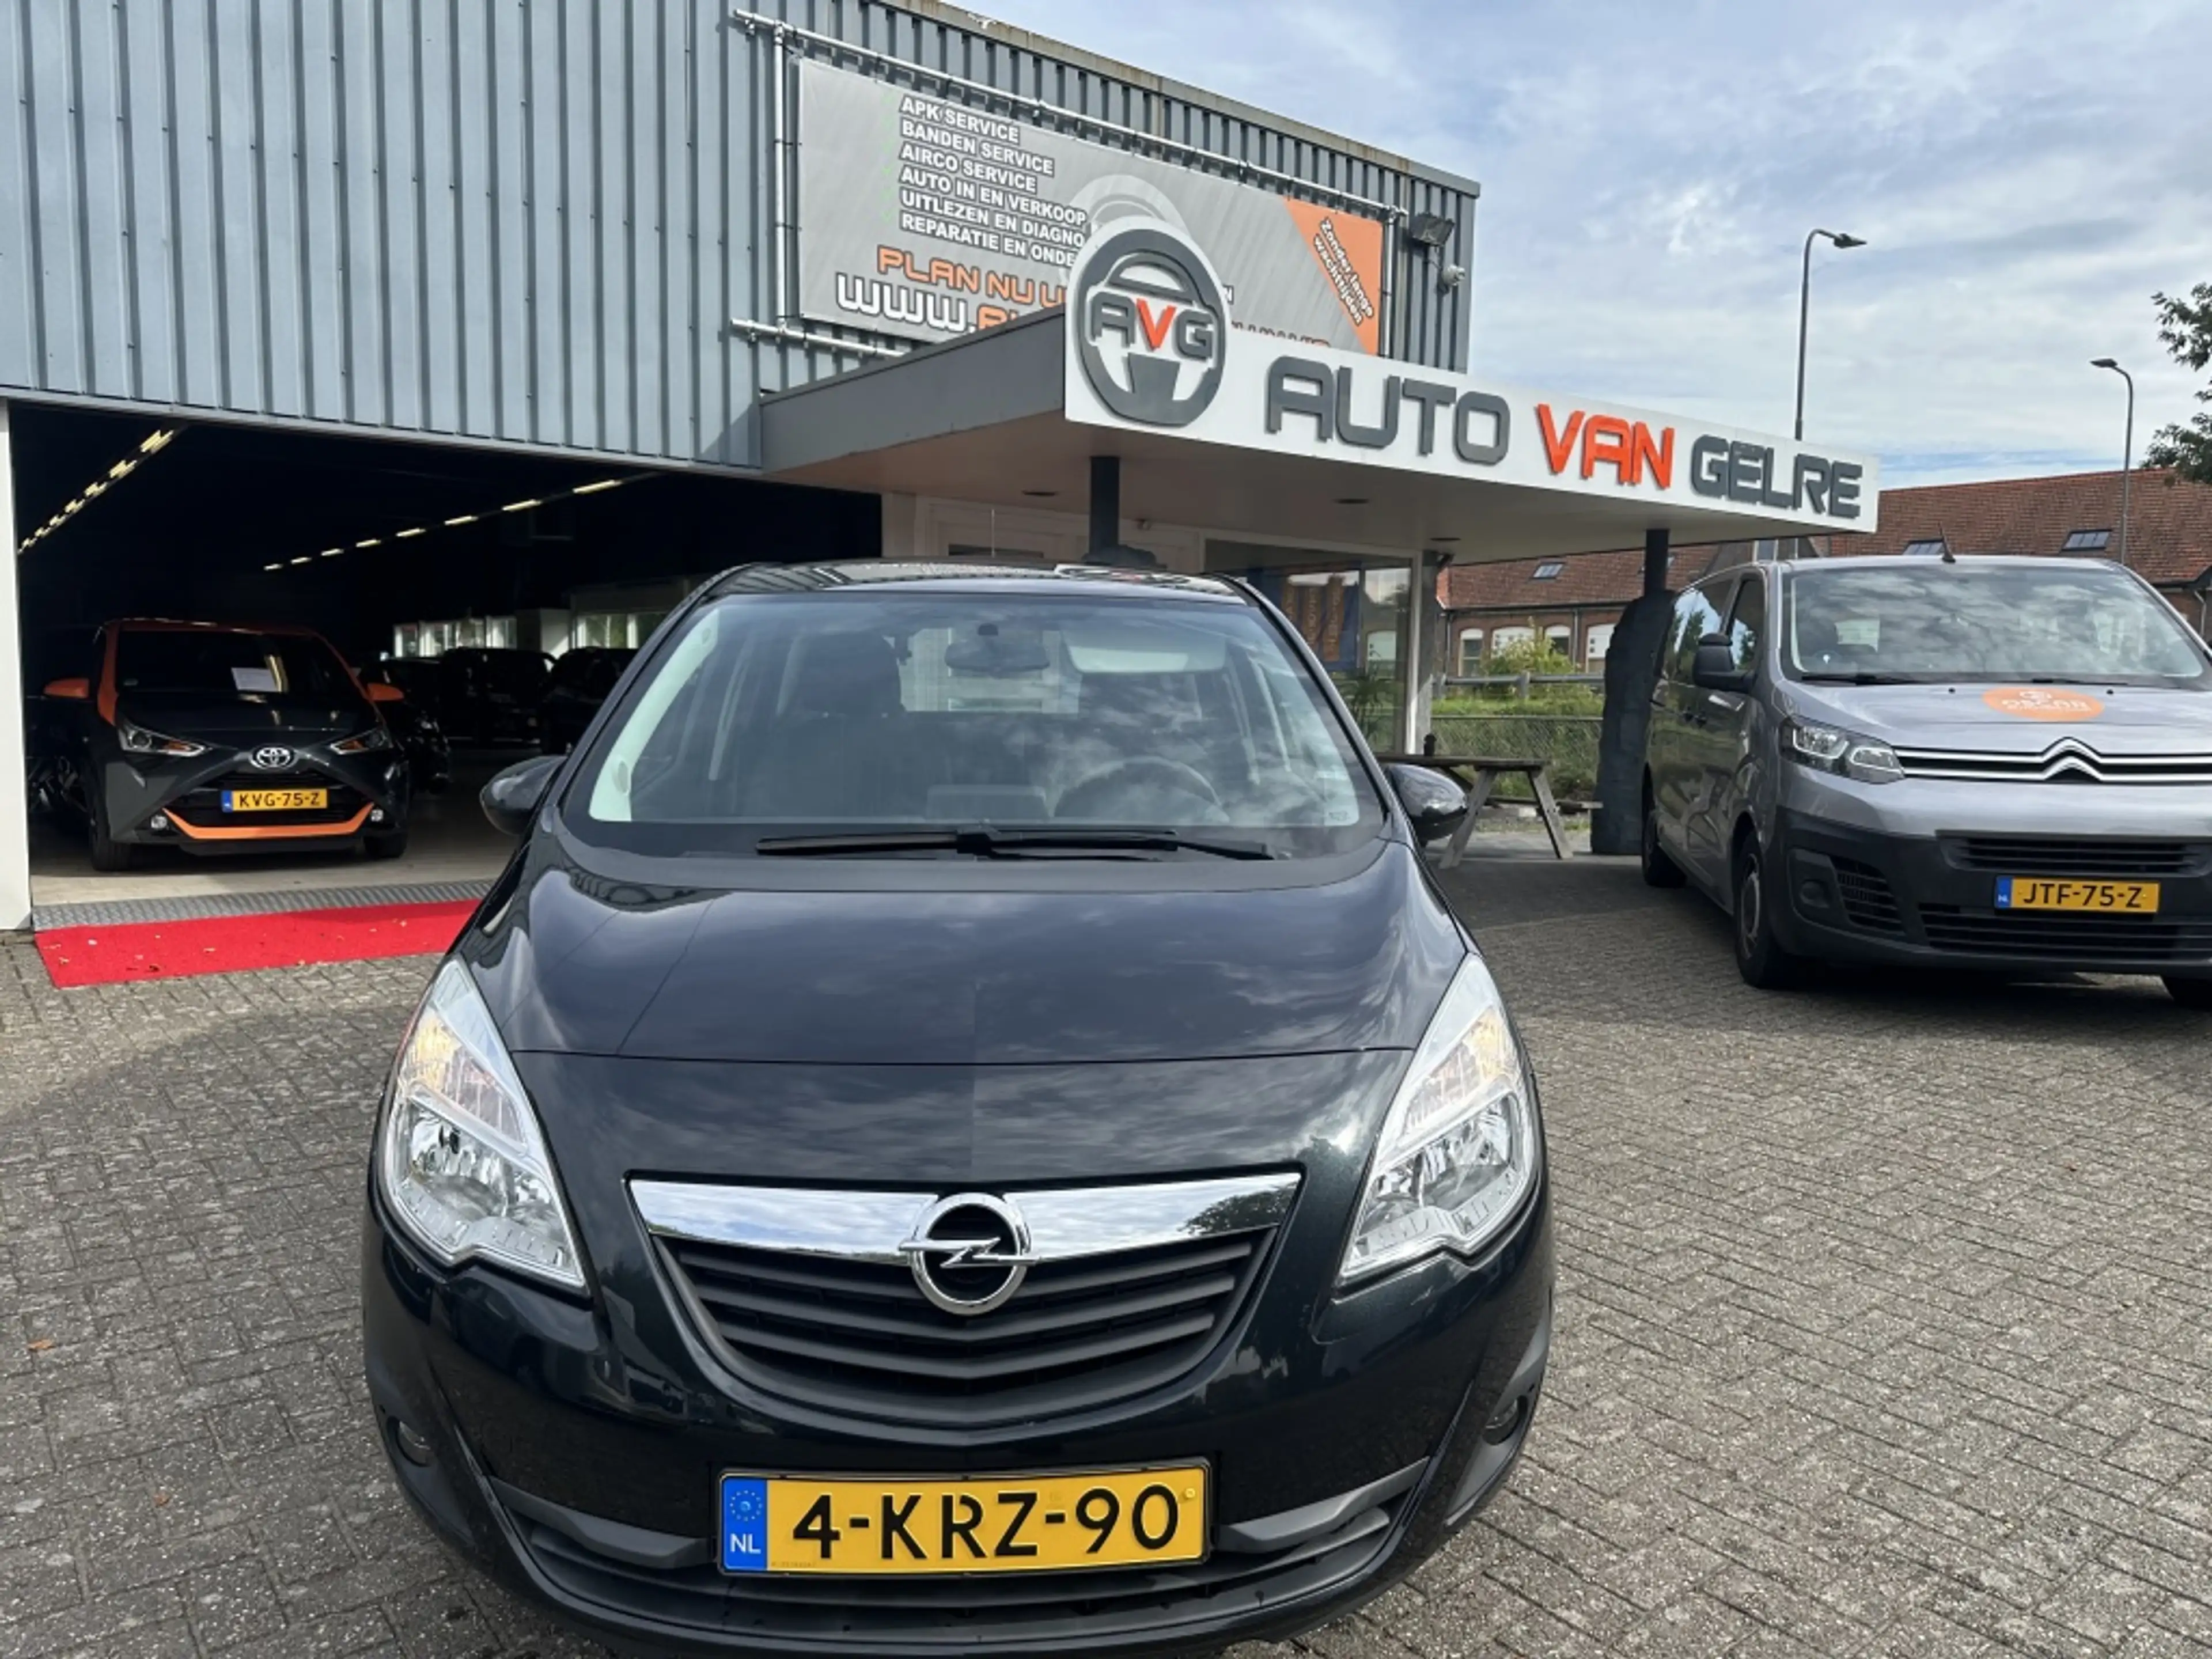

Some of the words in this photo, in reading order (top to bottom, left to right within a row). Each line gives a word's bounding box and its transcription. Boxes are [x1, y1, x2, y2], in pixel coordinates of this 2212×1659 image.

[902, 96, 940, 120] APK
[944, 109, 1019, 143] SERVICE
[902, 118, 976, 154] BANDEN
[980, 142, 1054, 175] SERVICE
[901, 166, 952, 192] AUTO
[956, 180, 975, 200] IN
[980, 187, 1003, 207] EN
[1008, 194, 1086, 225] VERKOOP
[902, 143, 959, 172] AIRCO
[962, 160, 1036, 193] SERVICE
[902, 189, 988, 225] UITLEZEN
[995, 213, 1016, 232] EN
[902, 214, 999, 251] REPARATIE
[1004, 237, 1027, 256] EN
[877, 245, 979, 294] PLAN
[986, 270, 1035, 305] NU
[1314, 236, 1362, 325] wachttijden
[1320, 218, 1351, 273] Zonder
[1350, 274, 1373, 317] lange
[1089, 291, 1214, 362] AVG
[1266, 356, 1510, 466] AUTO
[1535, 403, 1675, 490] VAN
[1691, 434, 1863, 520] GELRE
[239, 792, 320, 808] KVG-75-Z
[2022, 883, 2143, 908] JTF-75-Z
[730, 1532, 762, 1555] NL
[792, 1484, 1180, 1560] 4-KRZ-90
